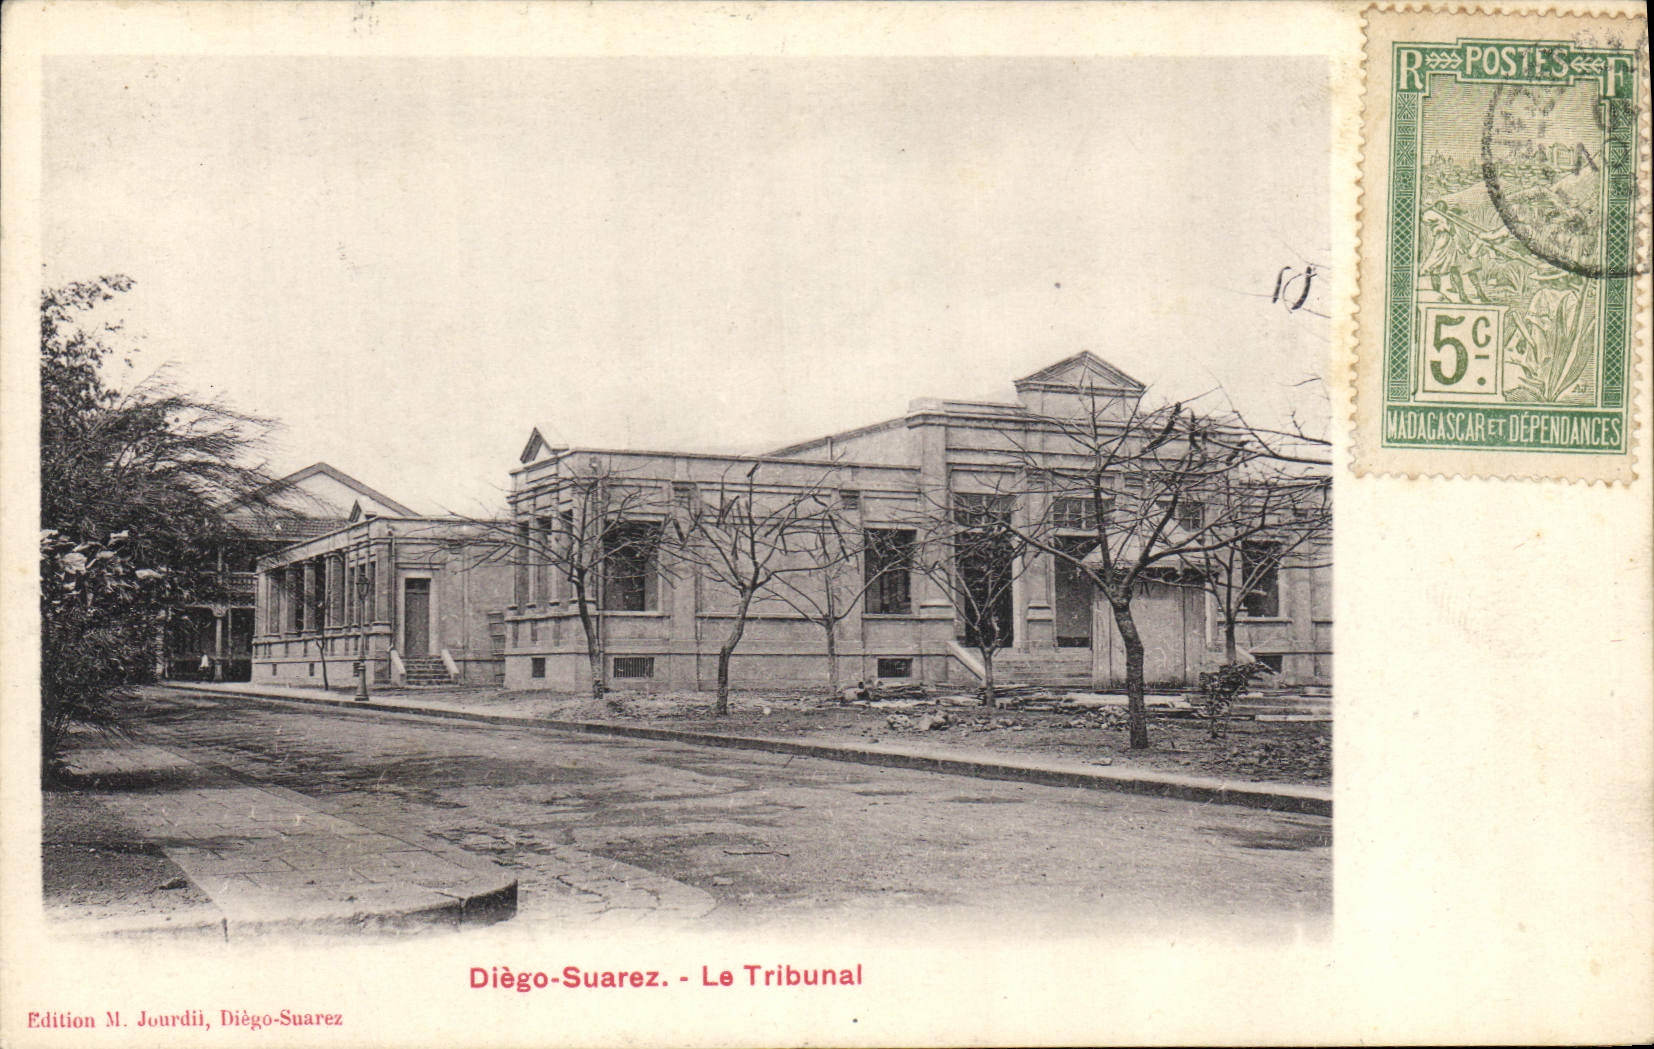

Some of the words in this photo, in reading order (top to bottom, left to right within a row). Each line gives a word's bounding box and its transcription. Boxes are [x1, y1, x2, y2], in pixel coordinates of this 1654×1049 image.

[1465, 45, 1570, 79] POSTES
[1387, 410, 1486, 442] MADAGASCAR
[1509, 411, 1622, 447] DÉPENDANCES
